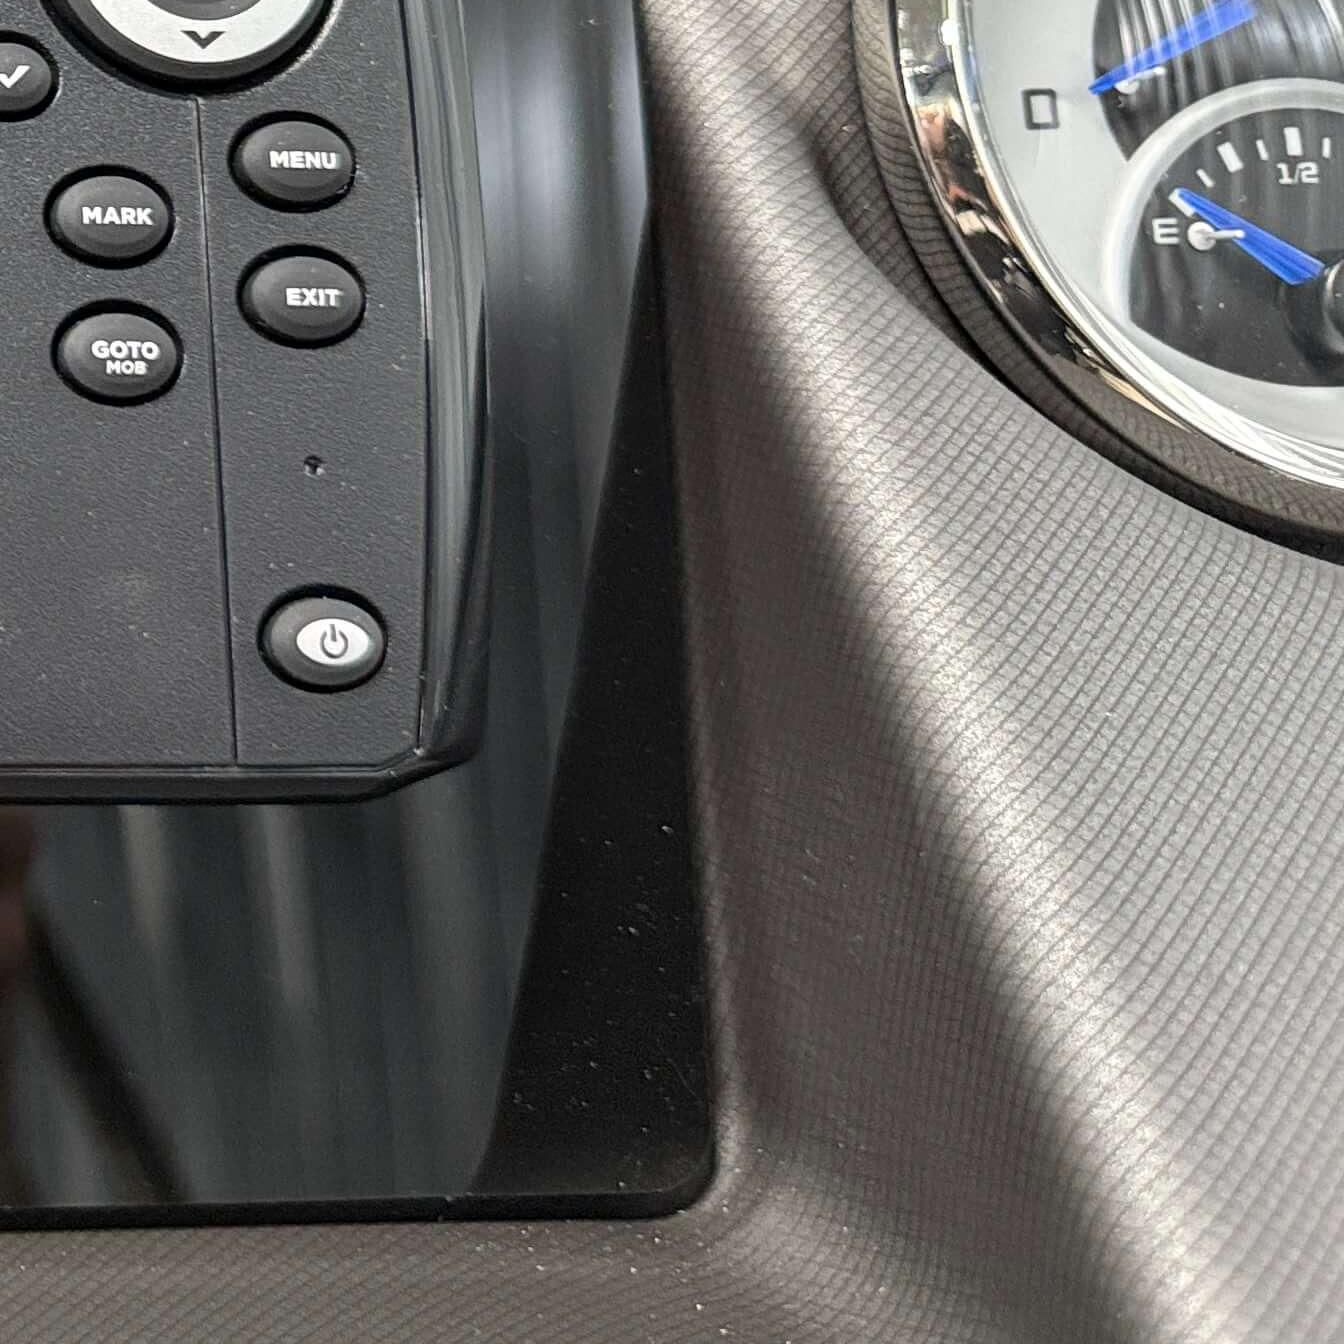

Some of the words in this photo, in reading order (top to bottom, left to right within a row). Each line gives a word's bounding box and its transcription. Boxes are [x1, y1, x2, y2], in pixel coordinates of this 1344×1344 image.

[1022, 88, 1059, 130] 0
[269, 150, 337, 170] MENU
[1277, 161, 1319, 184] 1/2
[82, 206, 153, 226] MARK
[1152, 217, 1179, 244] E
[285, 287, 343, 307] EXIT
[91, 339, 159, 360] GOTO
[106, 361, 147, 375] MOB
